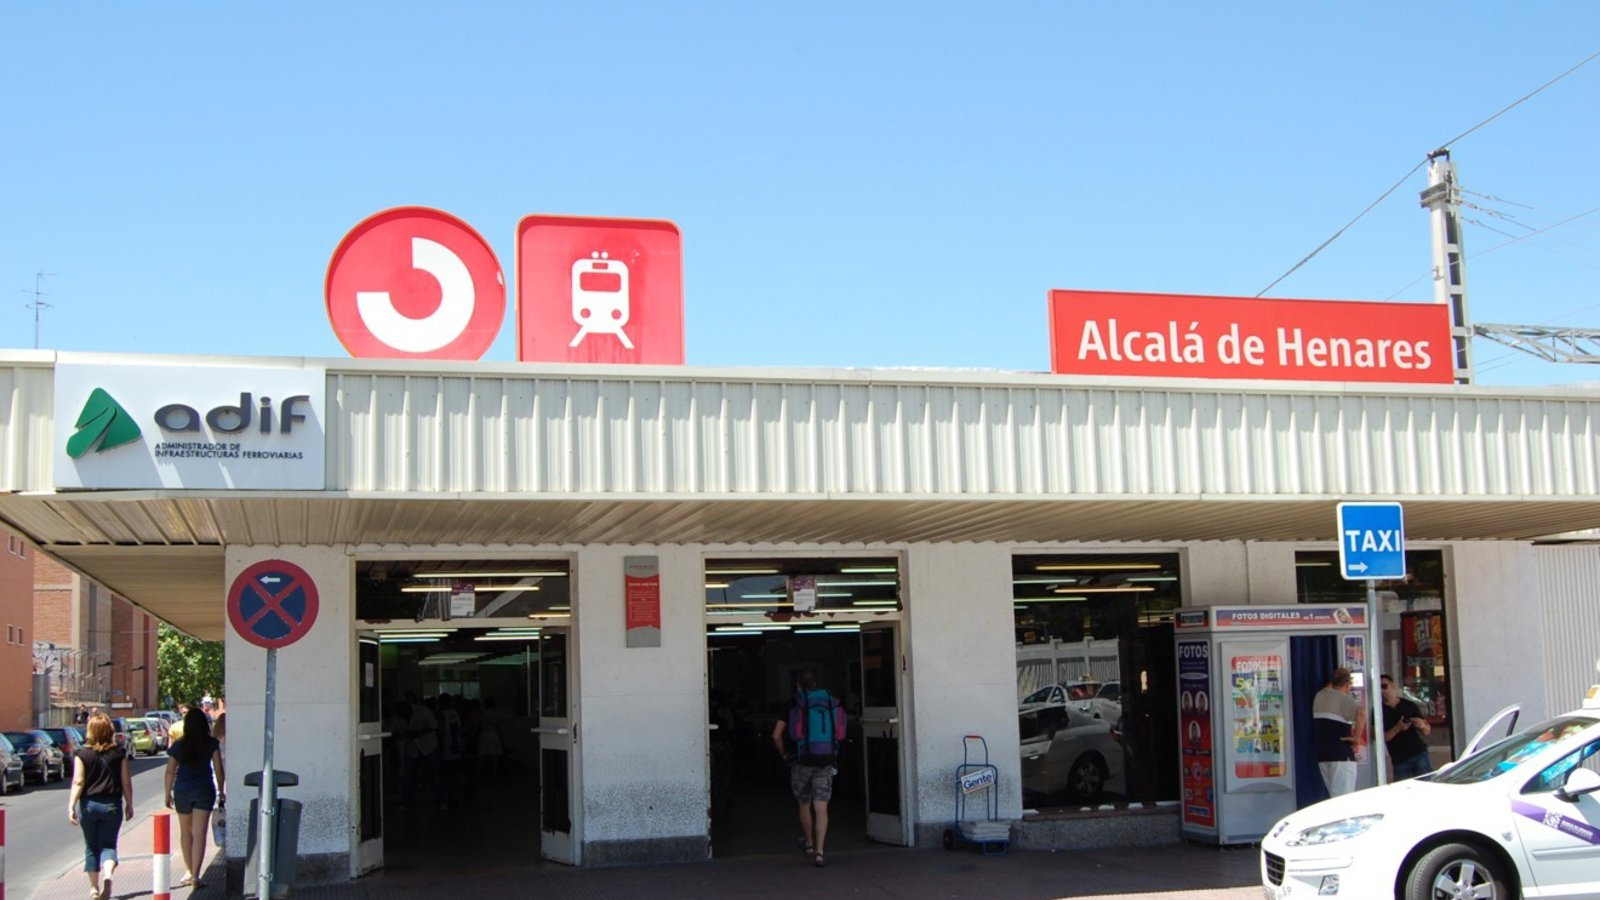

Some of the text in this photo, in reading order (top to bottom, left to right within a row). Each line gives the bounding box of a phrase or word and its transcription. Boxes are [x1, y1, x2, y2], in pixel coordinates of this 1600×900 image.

[1078, 318, 1432, 370] Alcalá de Henares
[154, 392, 310, 434] adif
[155, 442, 227, 450] ADMINISTRADOR
[155, 450, 303, 460] INFRAESTRUCTURAS FERROVIARIAS
[1345, 529, 1401, 552] TAXI
[1232, 612, 1258, 621] FOTOS
[1260, 611, 1301, 620] DIGITALES
[1179, 644, 1208, 658] FOTOS
[963, 774, 992, 789] Gente
